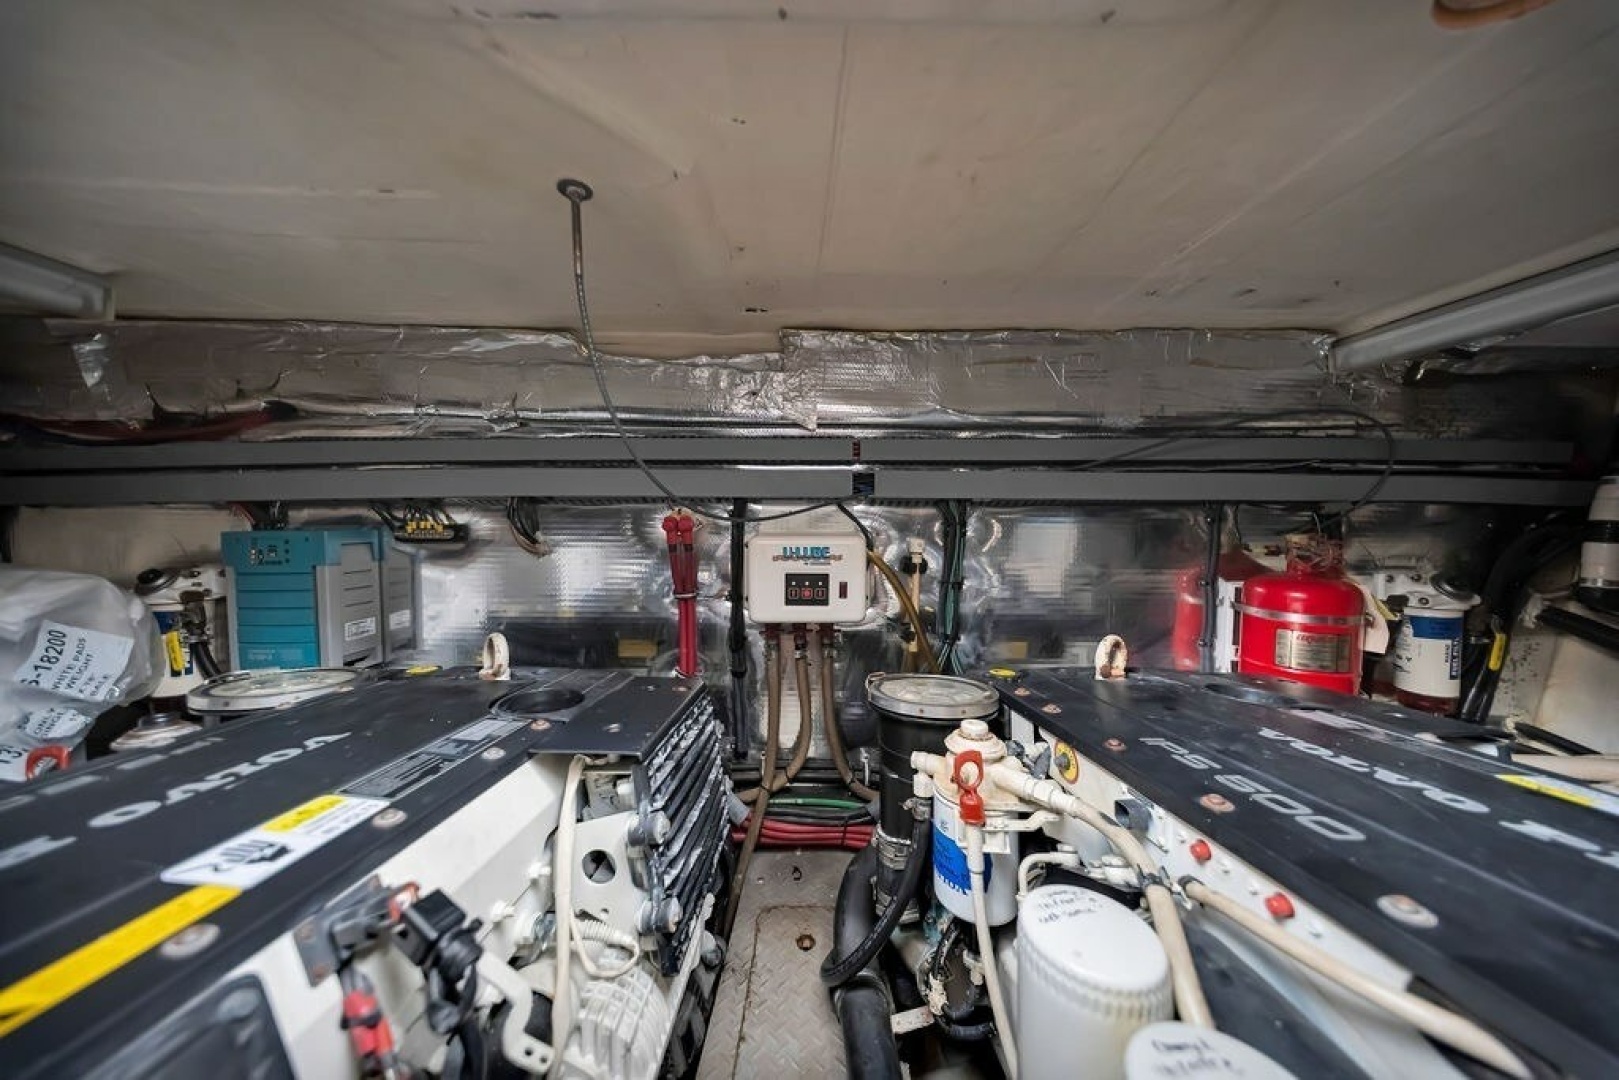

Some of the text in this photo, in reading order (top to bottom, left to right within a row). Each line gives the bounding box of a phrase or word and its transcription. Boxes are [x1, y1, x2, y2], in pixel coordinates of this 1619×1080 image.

[88, 731, 352, 828] VOLVO
[1138, 736, 1367, 843] IPS 500
[1257, 726, 1491, 814] VOLVO
